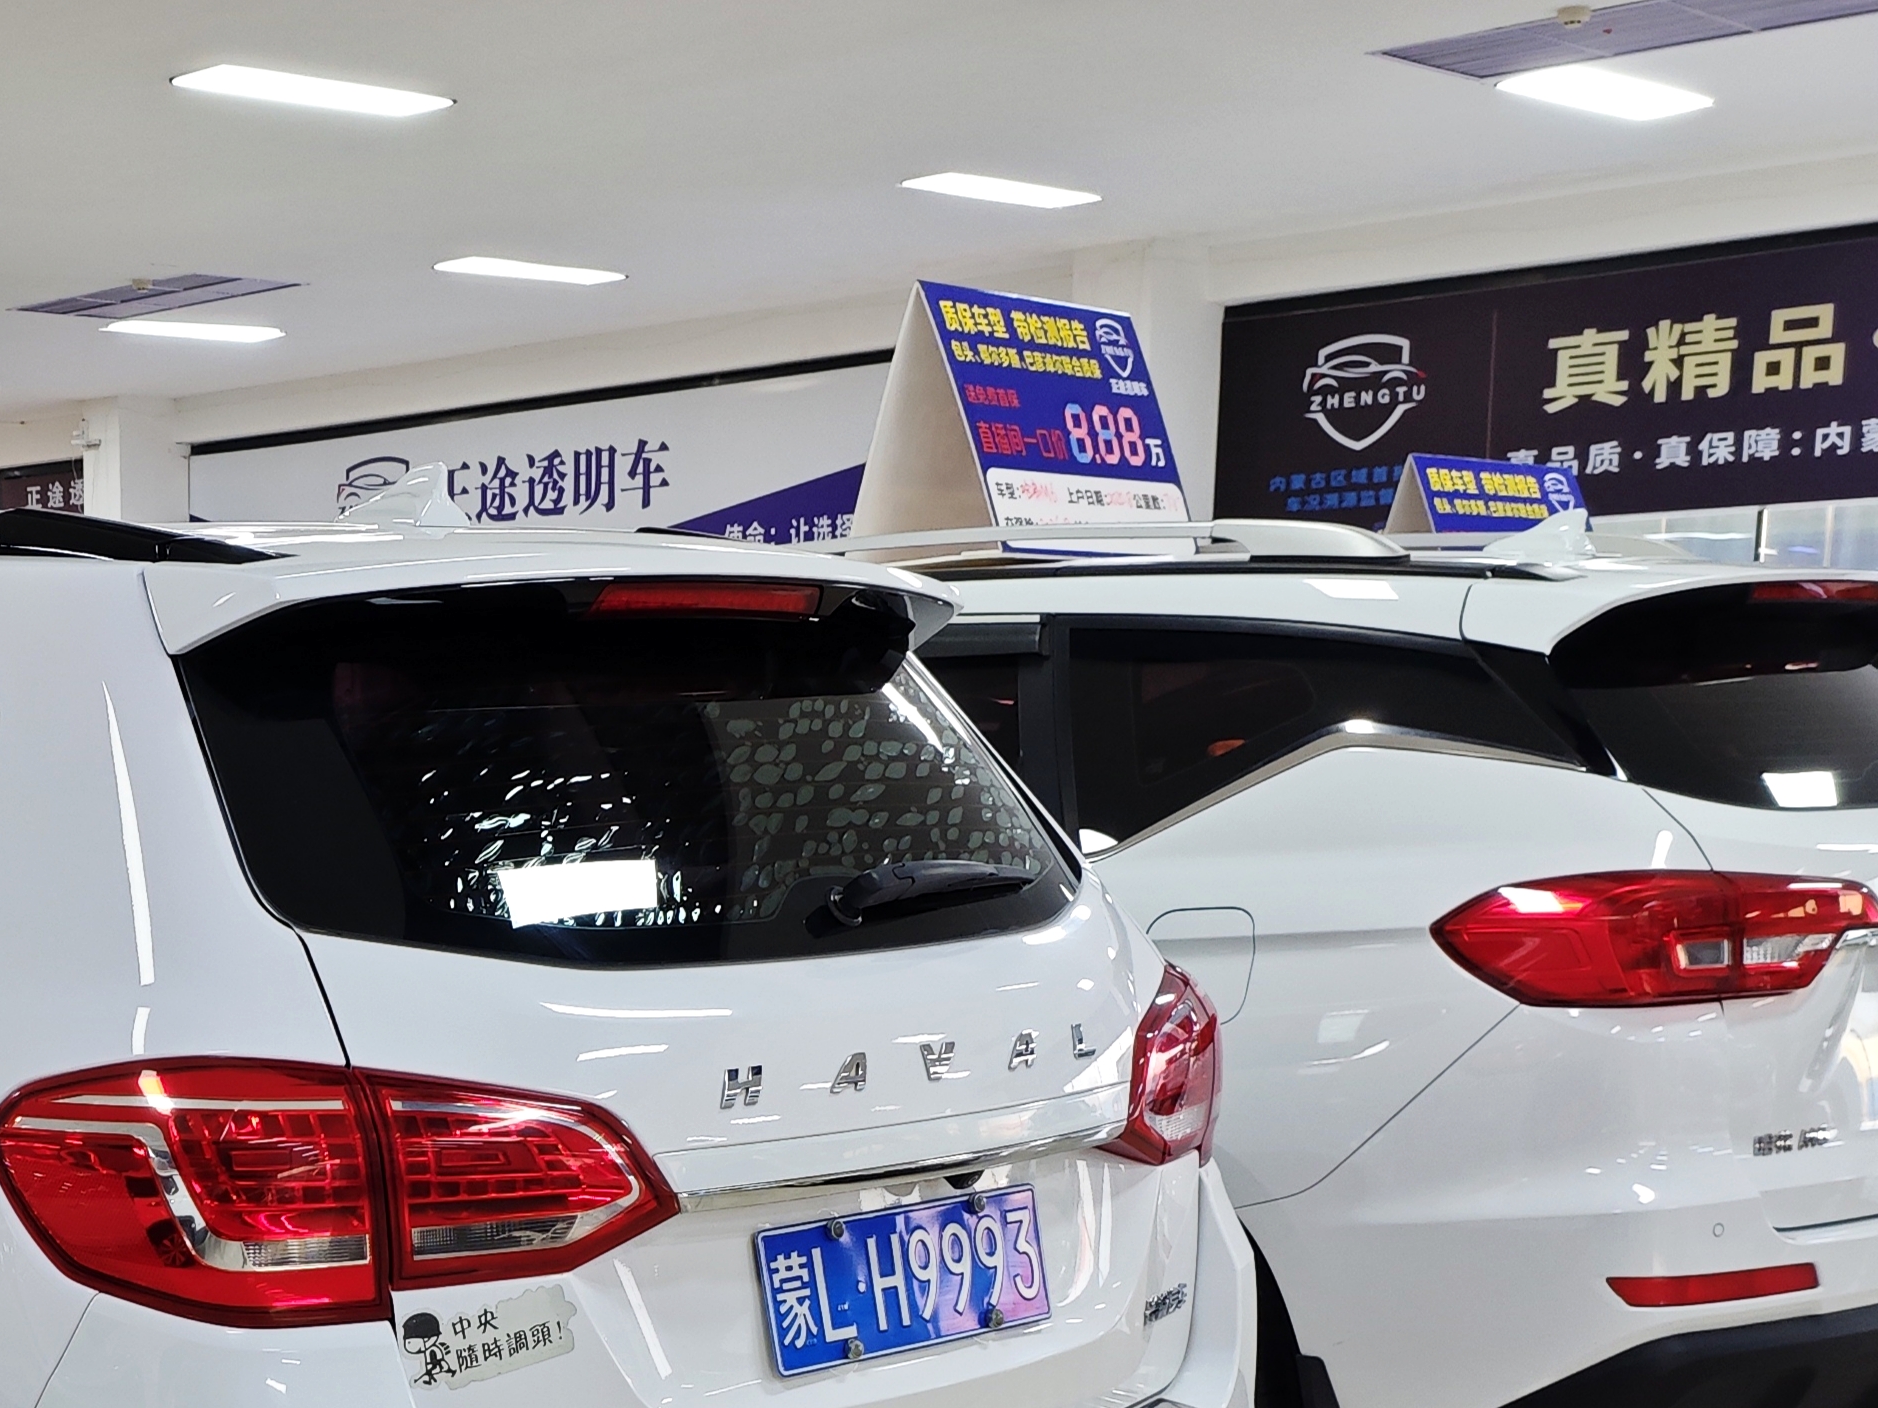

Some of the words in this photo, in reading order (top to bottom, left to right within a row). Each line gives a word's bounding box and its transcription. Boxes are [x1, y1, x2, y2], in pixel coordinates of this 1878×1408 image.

[938, 300, 1010, 339] 质保车型
[1010, 310, 1091, 351] 带检测报告
[1541, 302, 1846, 415] 真精品
[1309, 384, 1426, 412] ZHENGTU
[1145, 438, 1166, 468] 万
[719, 1022, 1097, 1111] HAVAL
[451, 1308, 500, 1341] 中央
